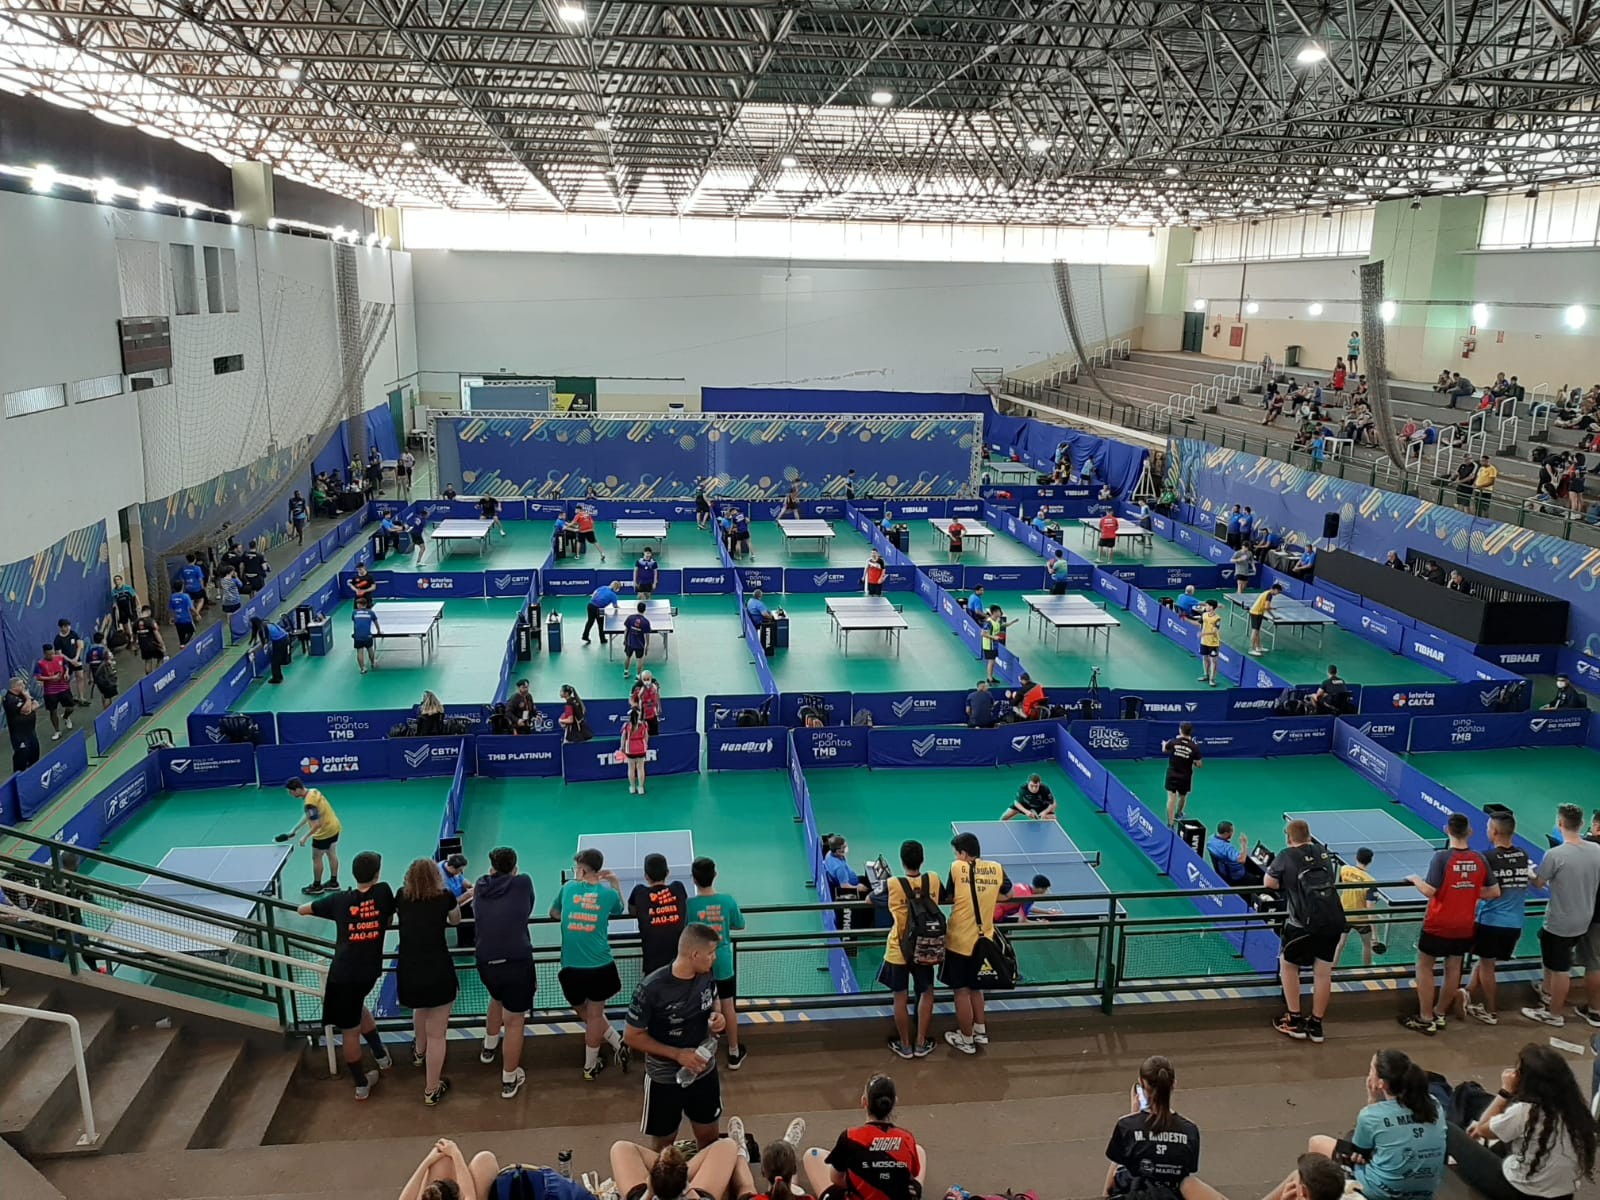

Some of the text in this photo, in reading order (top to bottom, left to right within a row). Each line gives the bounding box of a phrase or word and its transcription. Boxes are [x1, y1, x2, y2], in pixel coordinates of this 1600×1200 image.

[1414, 642, 1445, 663] TIBHAR
[1500, 654, 1541, 663] TIBHAR
[914, 699, 937, 708] CBTM
[1145, 703, 1182, 712] TIBHAR
[327, 714, 354, 724] ping-
[328, 729, 355, 739] TMB
[1090, 728, 1124, 740] PING-
[1371, 725, 1395, 733] CBTM
[812, 731, 838, 742] ping-
[1451, 732, 1472, 742] TMB
[720, 739, 768, 753] HandDry
[814, 738, 853, 748] -pontos
[936, 737, 961, 747] CBTM
[1089, 737, 1130, 749] -PONG
[431, 747, 458, 756] CBTM
[488, 751, 552, 761] TMB PLATINUM
[812, 747, 837, 757] TMB
[322, 755, 359, 765] loterias
[323, 763, 359, 772] CAIXA
[1420, 791, 1433, 804] TMB
[1140, 815, 1153, 834] CBTM
[961, 866, 969, 874] G.
[650, 914, 680, 925] JAÚ-SP
[349, 931, 379, 941] JAÚ-SP
[1384, 1117, 1394, 1128] G.
[1134, 1130, 1188, 1144] M. MODESTO
[1413, 1127, 1424, 1139] SP
[869, 1136, 902, 1151] SOGIPA
[1156, 1145, 1167, 1155] SP
